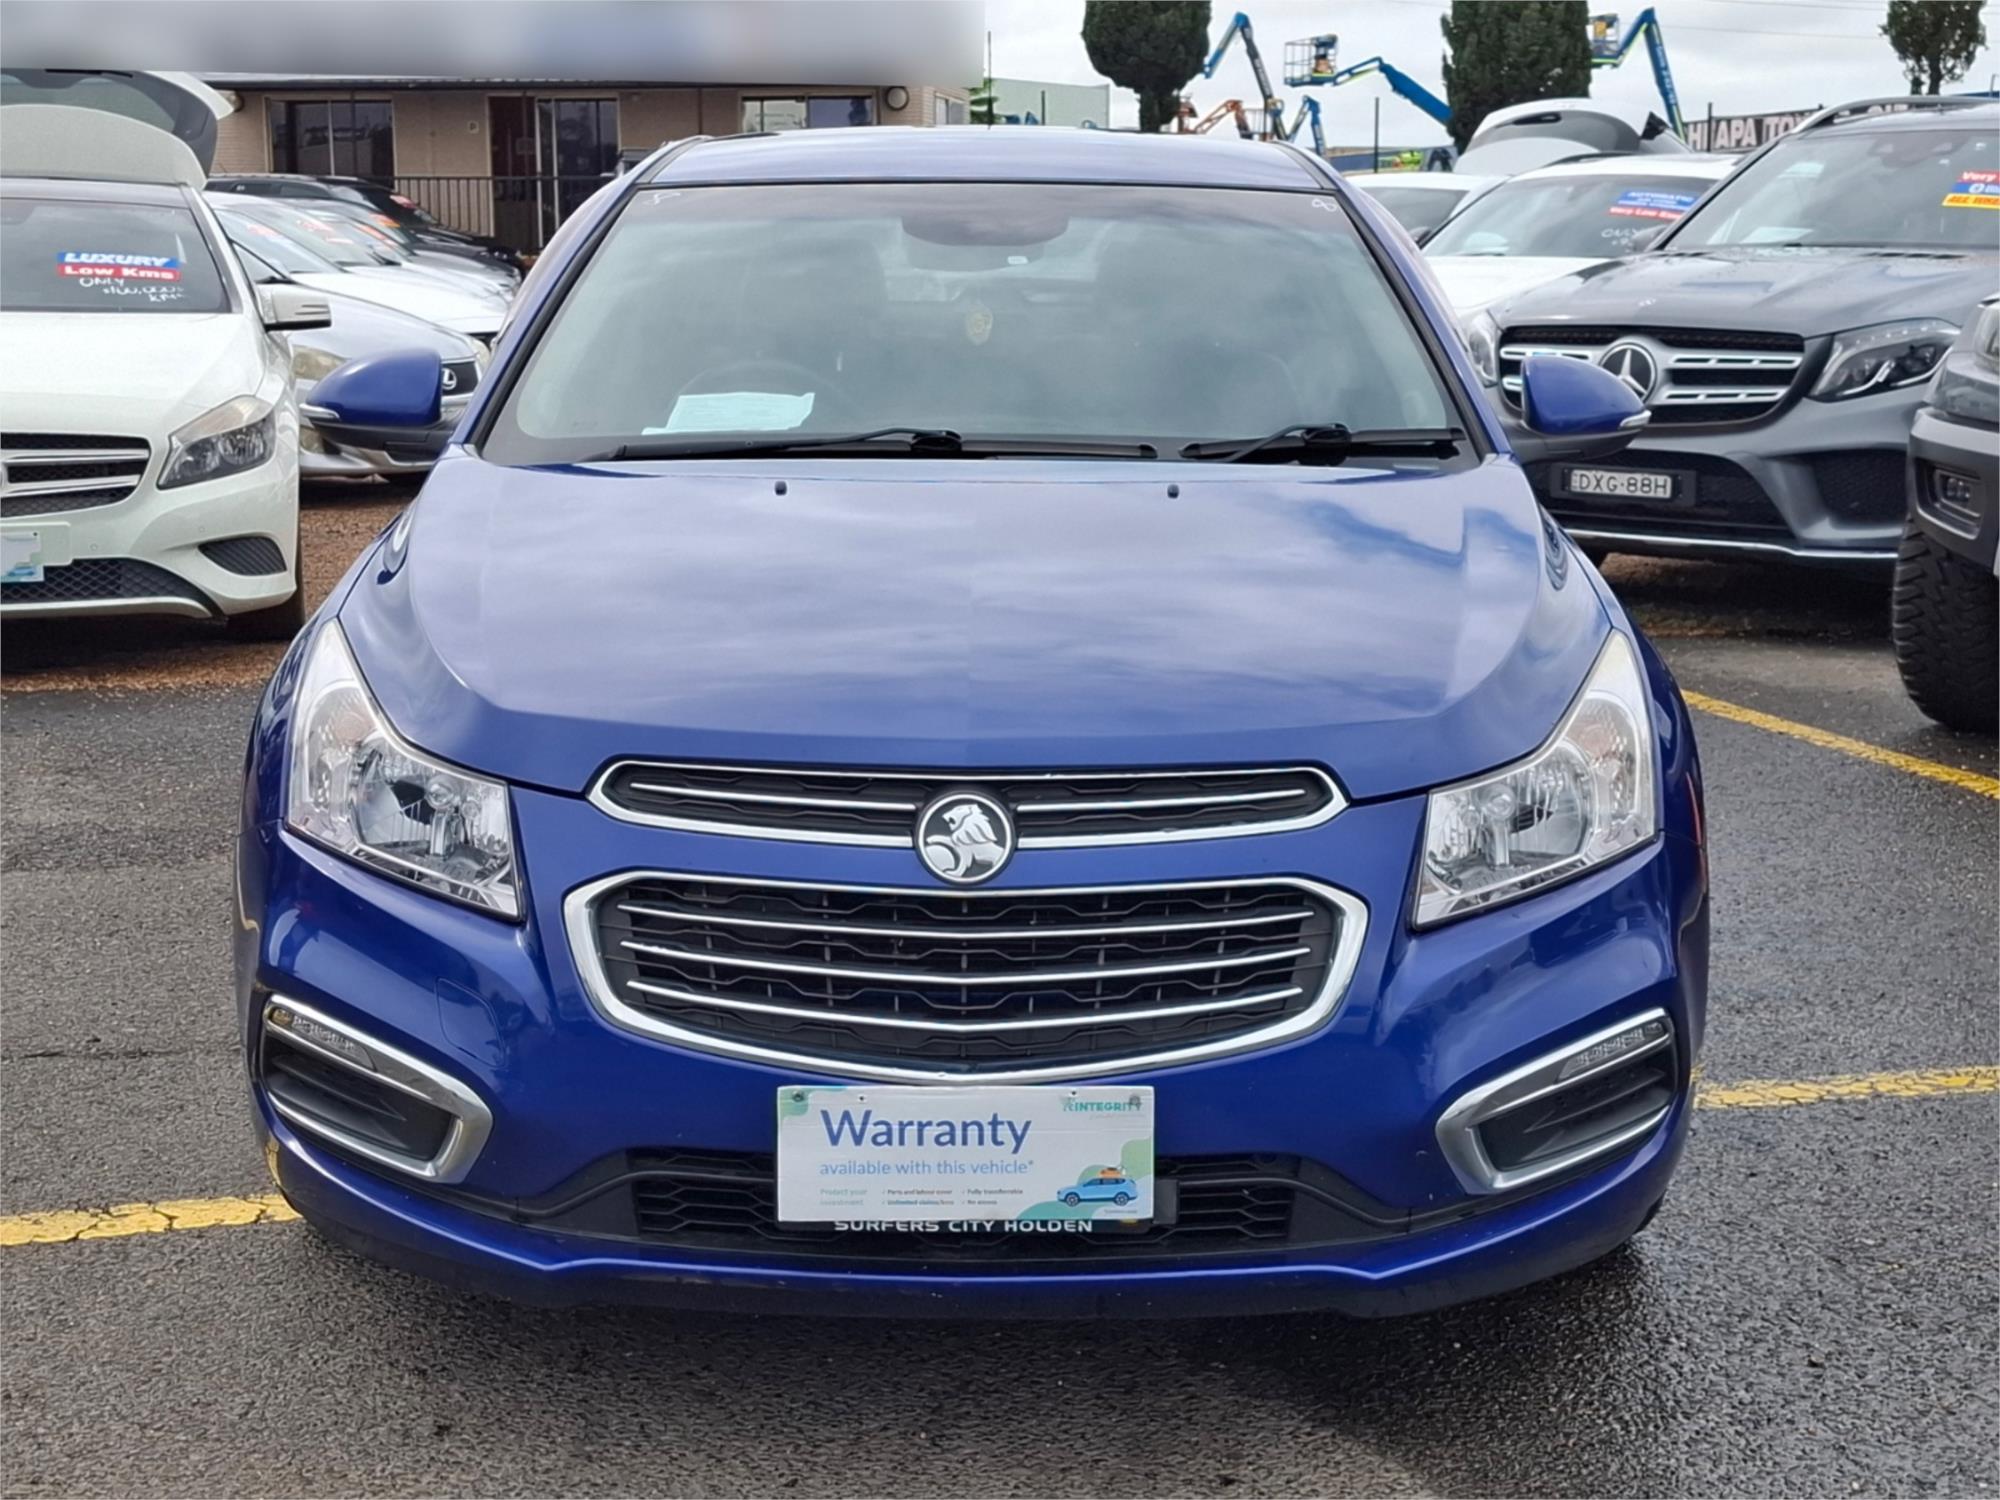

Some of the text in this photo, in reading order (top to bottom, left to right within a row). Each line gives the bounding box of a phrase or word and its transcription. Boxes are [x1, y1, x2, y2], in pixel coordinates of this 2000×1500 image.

[64, 253, 169, 267] LUXURY
[64, 265, 174, 280] Low Kms
[1074, 1101, 1142, 1112] INTEGRITY
[820, 1109, 1032, 1154] Warranty
[820, 1161, 891, 1174] available
[895, 1160, 932, 1174] with
[936, 1160, 966, 1174] this
[834, 1220, 1093, 1233] SURFERS CITY HOLDEN
